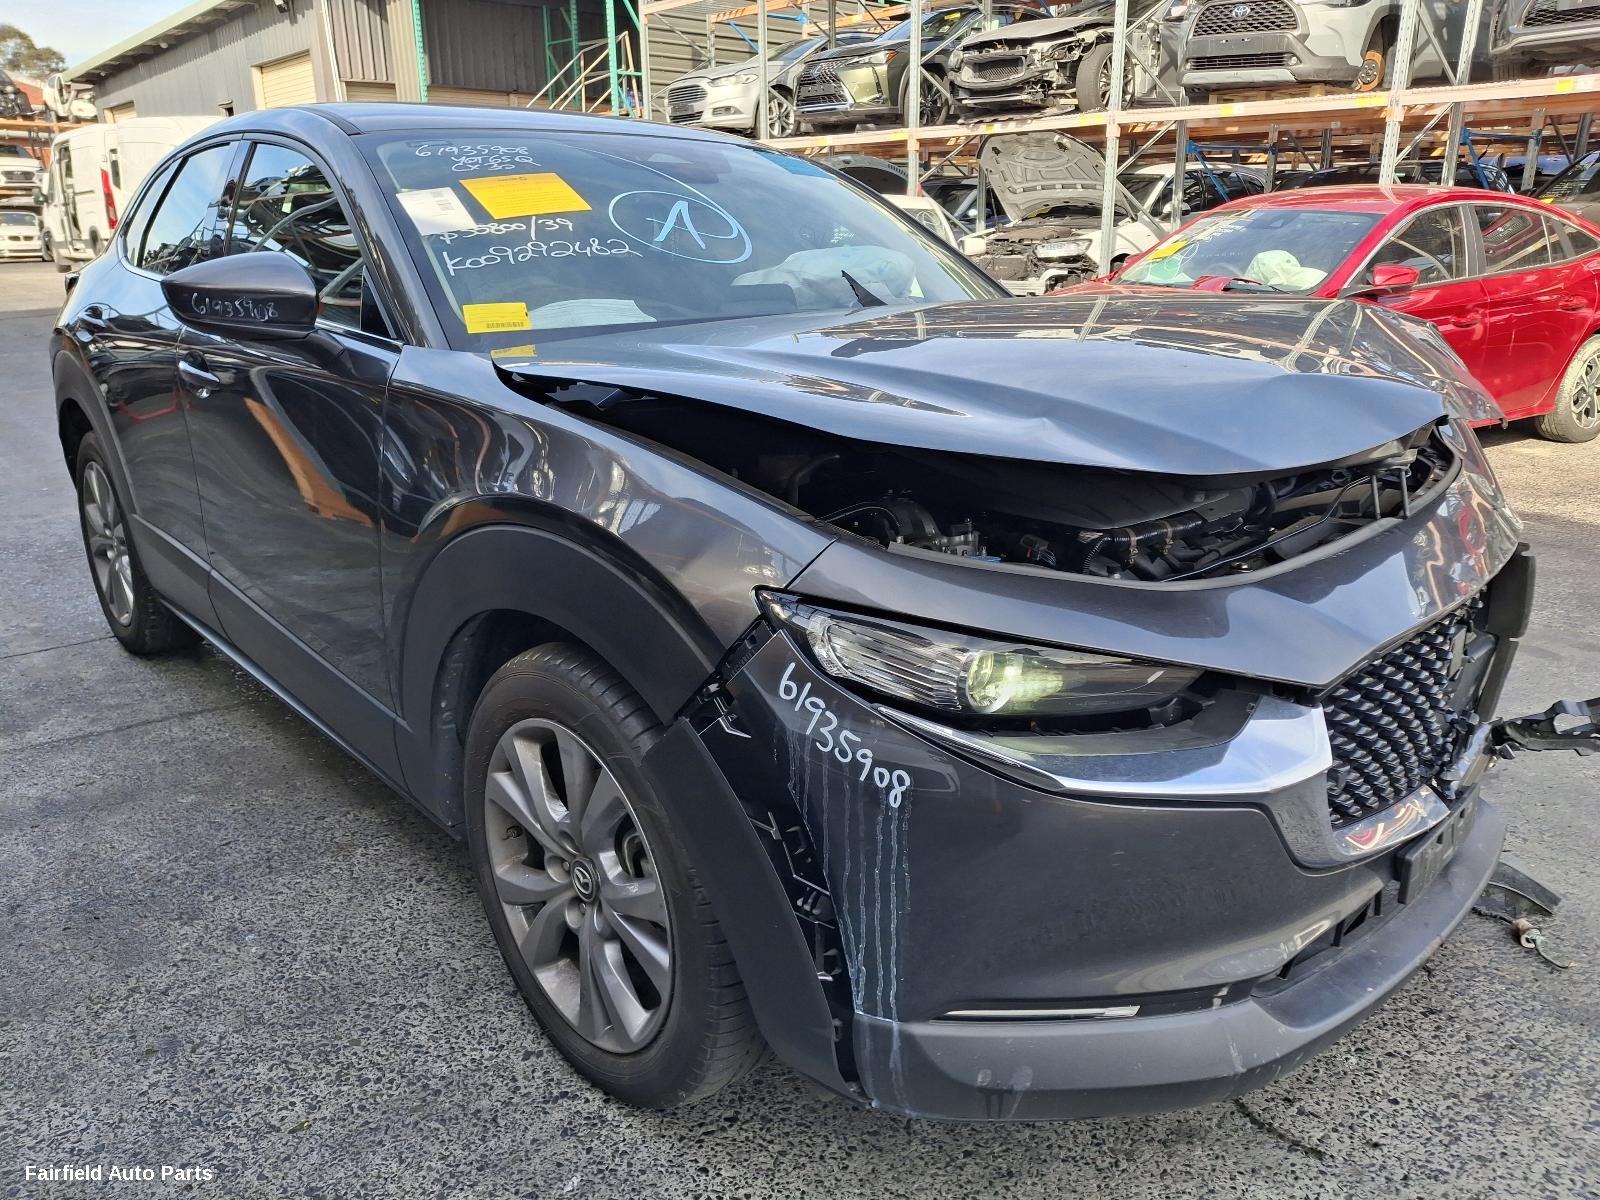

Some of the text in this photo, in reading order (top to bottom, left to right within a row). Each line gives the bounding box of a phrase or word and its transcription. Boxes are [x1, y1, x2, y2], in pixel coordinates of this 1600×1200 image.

[415, 145, 529, 156] 61935908
[192, 292, 279, 321] 61935908
[779, 662, 911, 808] 61935908
